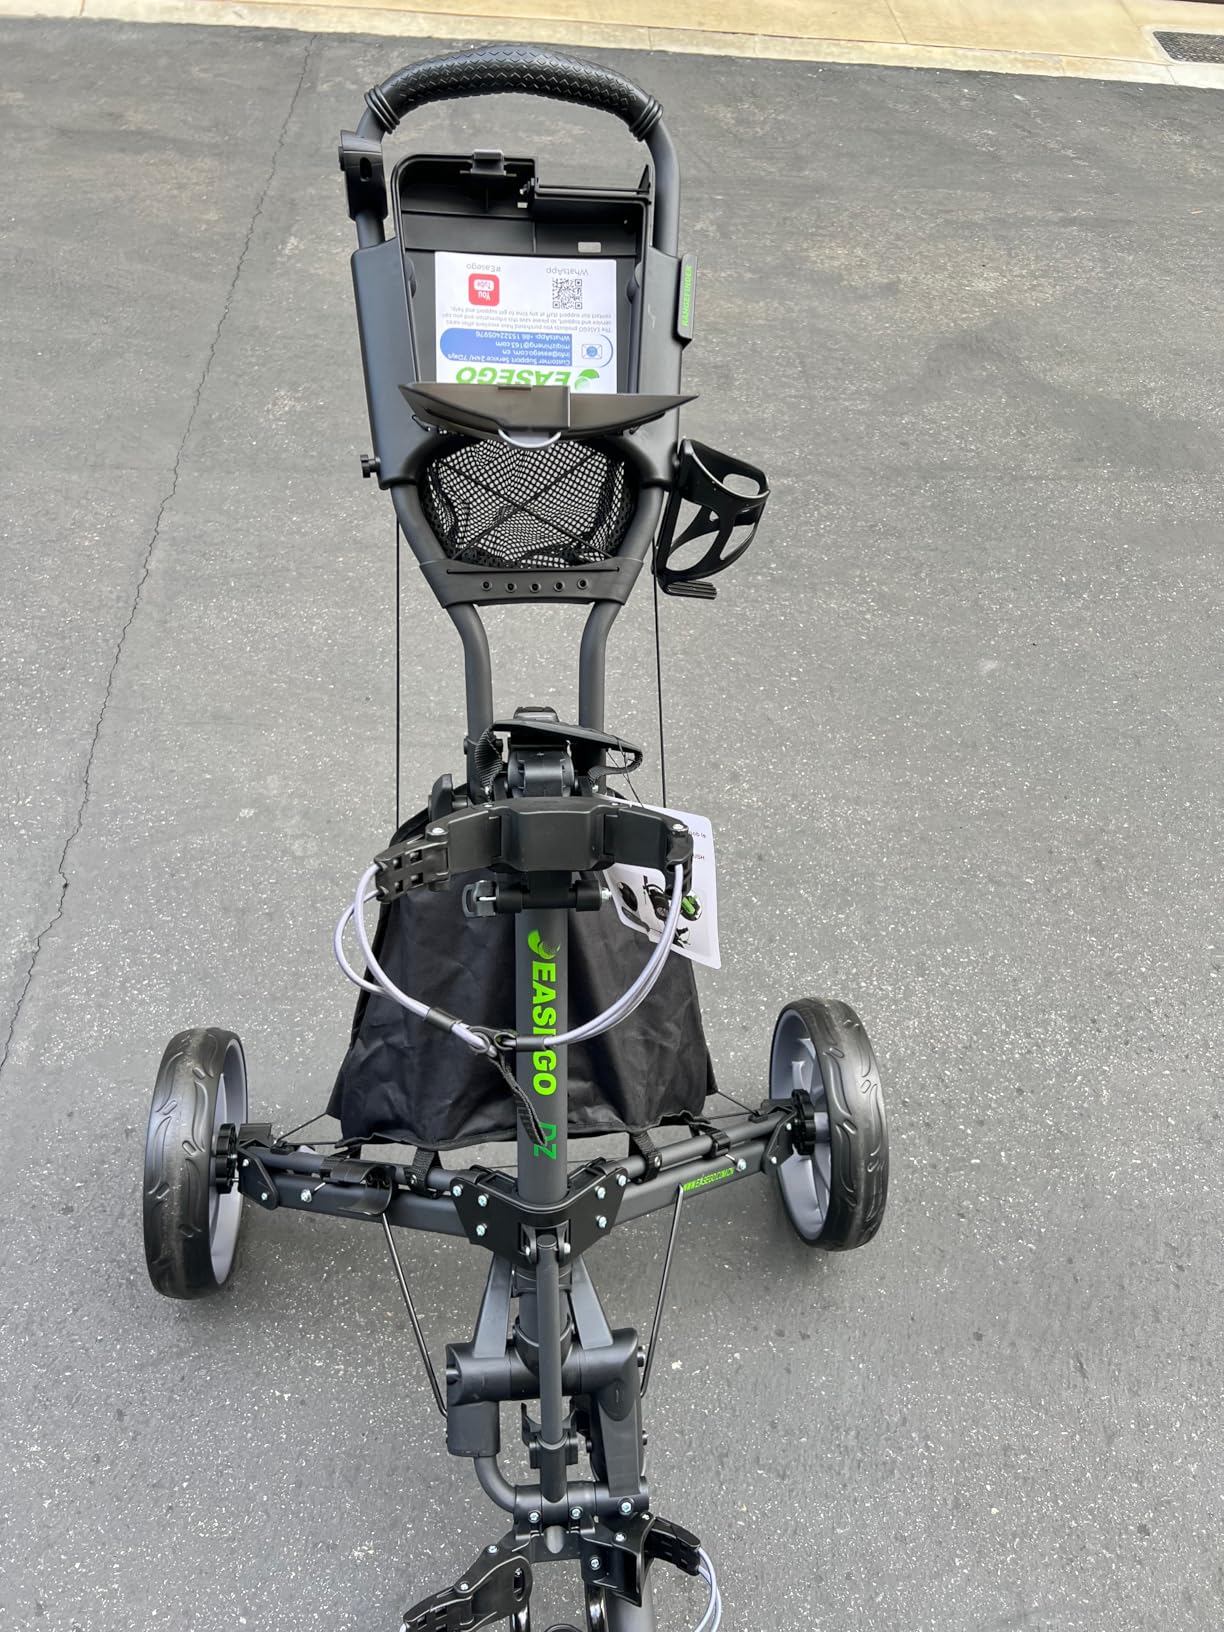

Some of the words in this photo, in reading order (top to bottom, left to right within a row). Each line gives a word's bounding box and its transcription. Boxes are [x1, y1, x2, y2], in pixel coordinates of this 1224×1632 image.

[466, 263, 501, 272] #Easego
[546, 267, 588, 276] WhatsApp
[477, 281, 491, 290] Tube
[478, 291, 491, 300] You
[680, 264, 692, 327] RANGEFINDER
[456, 368, 571, 385] EASEGO
